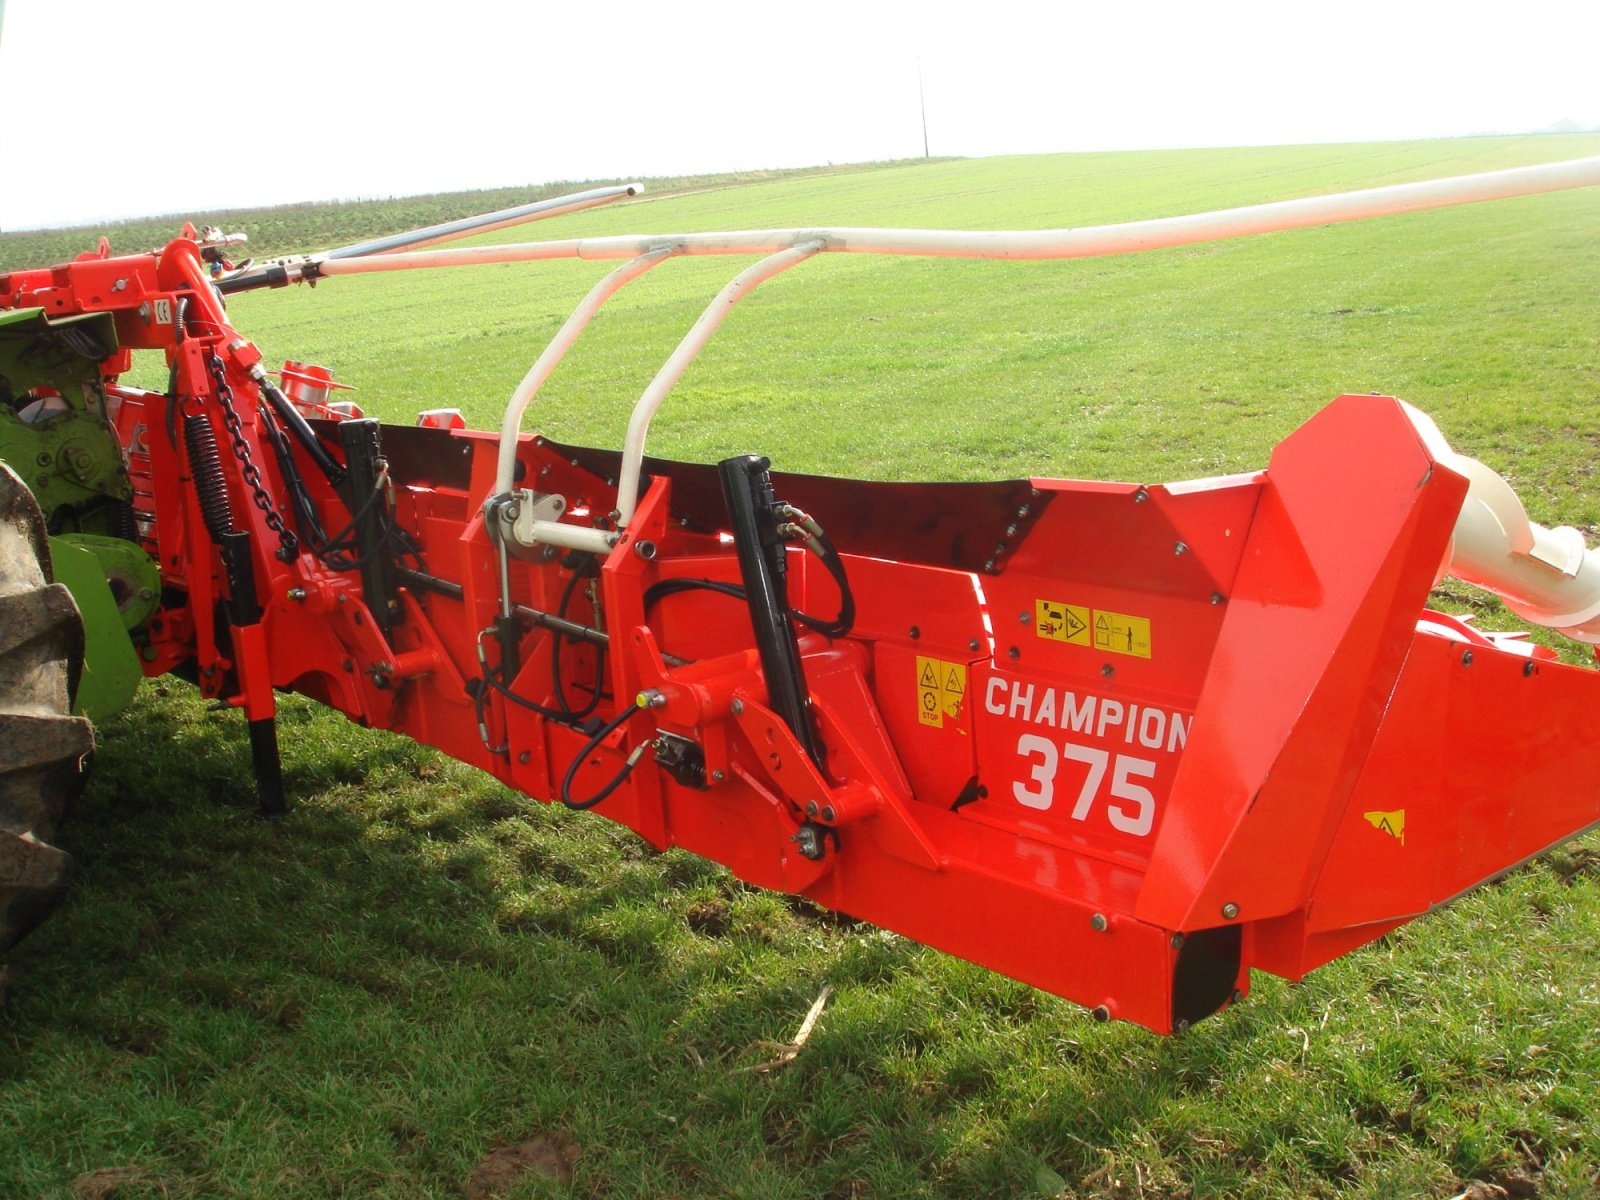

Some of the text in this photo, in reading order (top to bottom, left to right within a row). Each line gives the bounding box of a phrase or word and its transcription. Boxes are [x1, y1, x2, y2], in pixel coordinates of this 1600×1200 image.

[922, 711, 939, 721] STOP
[985, 676, 1194, 753] CHAMPION
[1012, 733, 1157, 837] 375
